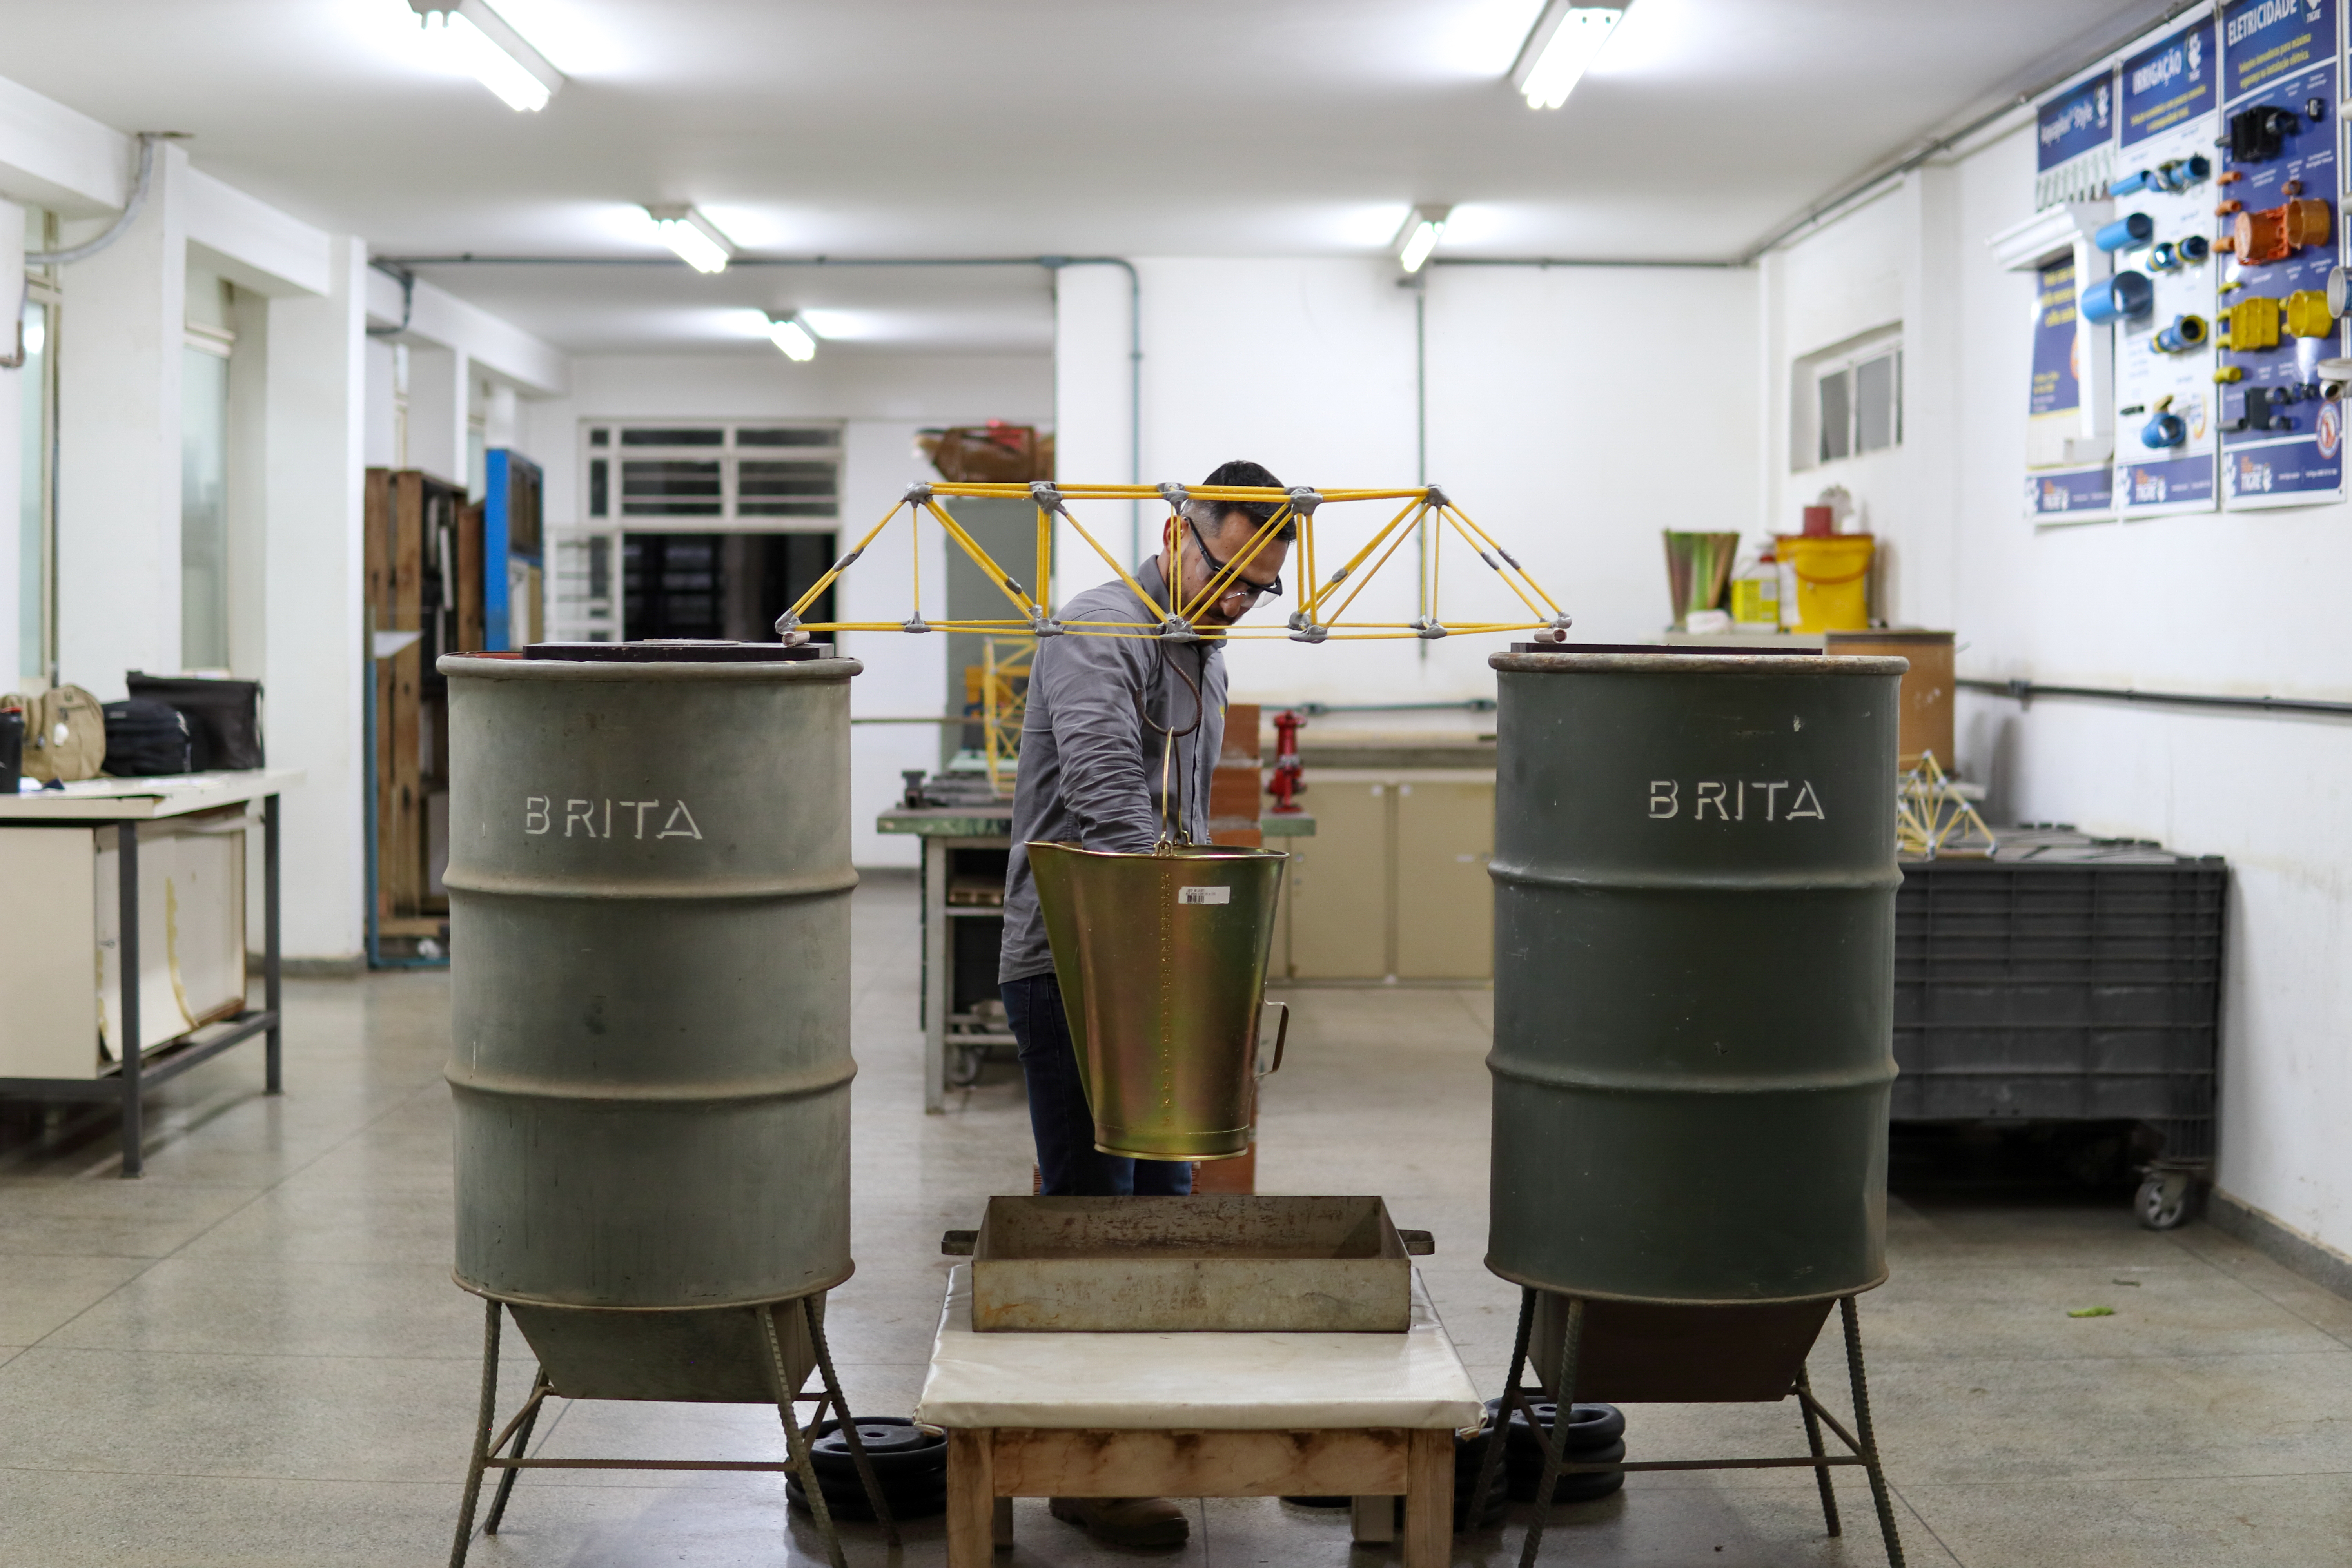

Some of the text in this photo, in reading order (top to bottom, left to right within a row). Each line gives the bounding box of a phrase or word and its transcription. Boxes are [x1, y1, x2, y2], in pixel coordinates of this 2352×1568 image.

[2228, 0, 2298, 47] ELETRICIDADE
[2132, 47, 2182, 96] IRRIGAÇÃO
[2241, 472, 2262, 491] TIGRE
[525, 795, 703, 839] BRITA
[1648, 779, 1826, 821] BRITA
